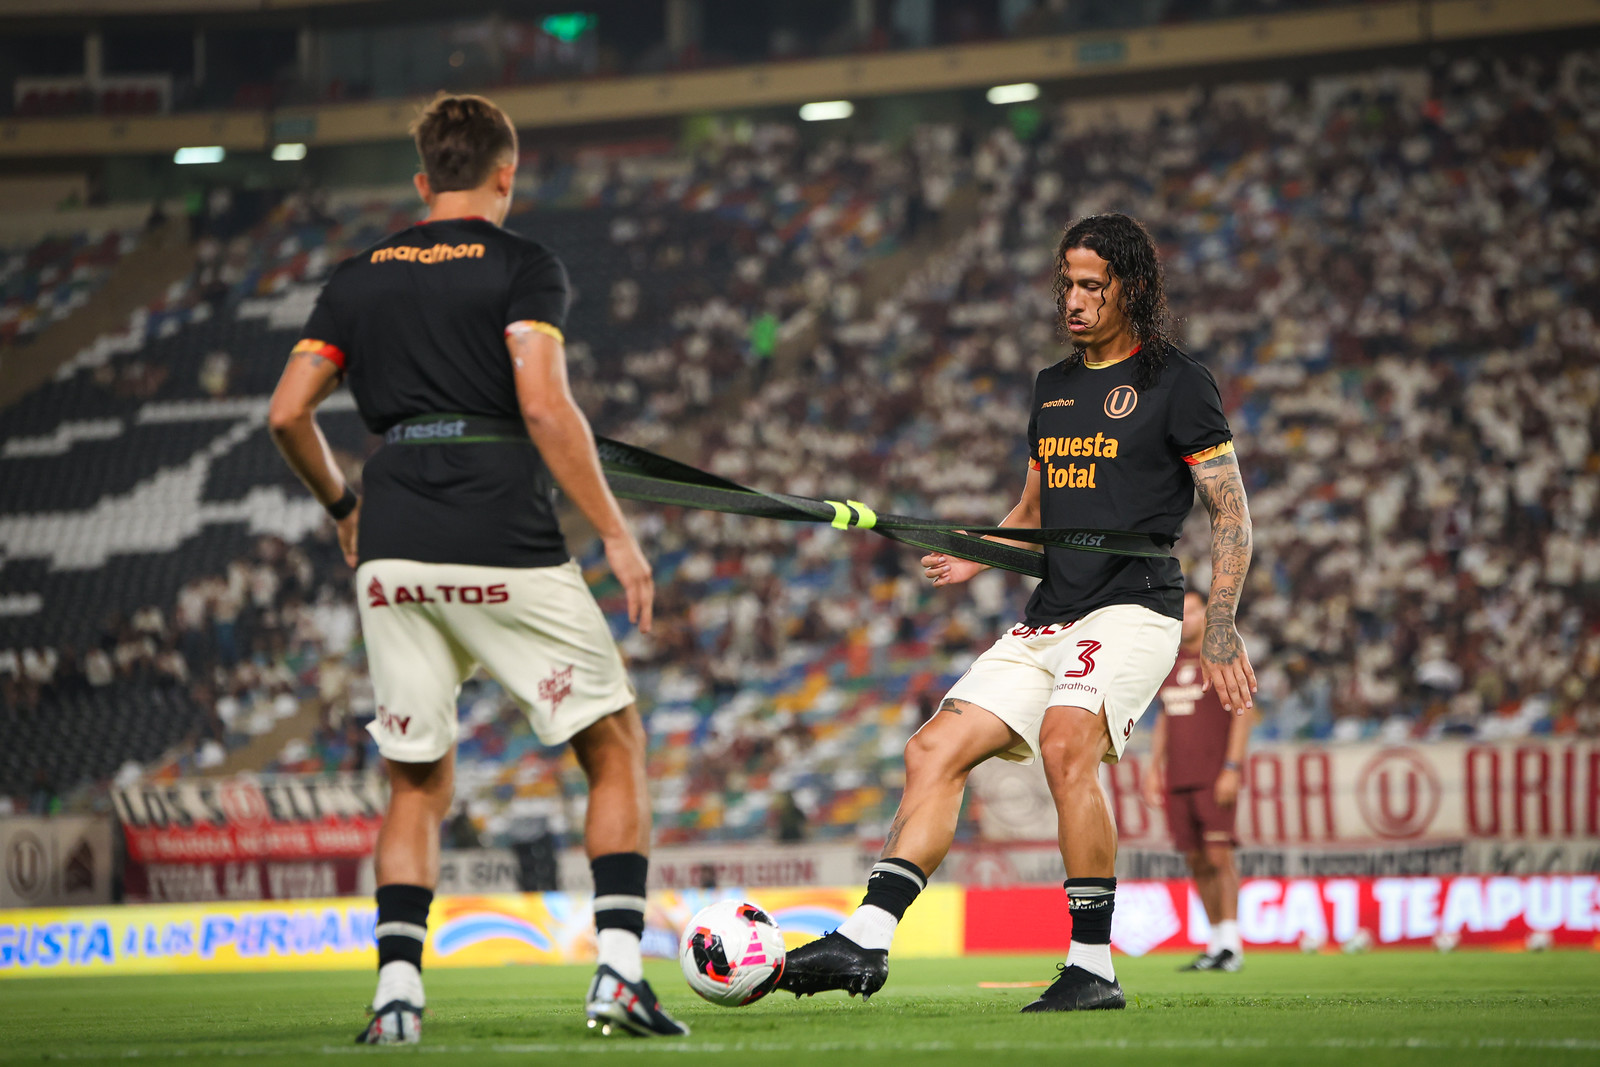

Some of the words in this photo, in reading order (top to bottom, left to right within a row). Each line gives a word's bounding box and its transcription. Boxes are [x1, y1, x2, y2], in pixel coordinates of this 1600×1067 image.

[370, 243, 485, 264] marathon
[1041, 398, 1074, 409] marathon
[405, 420, 466, 440] resist
[1038, 431, 1119, 463] apuesta
[1047, 462, 1096, 488] total
[394, 584, 510, 605] ALTOS
[1064, 640, 1102, 677] 3
[1187, 878, 1360, 945] LGA1
[198, 908, 379, 959] PERUAN
